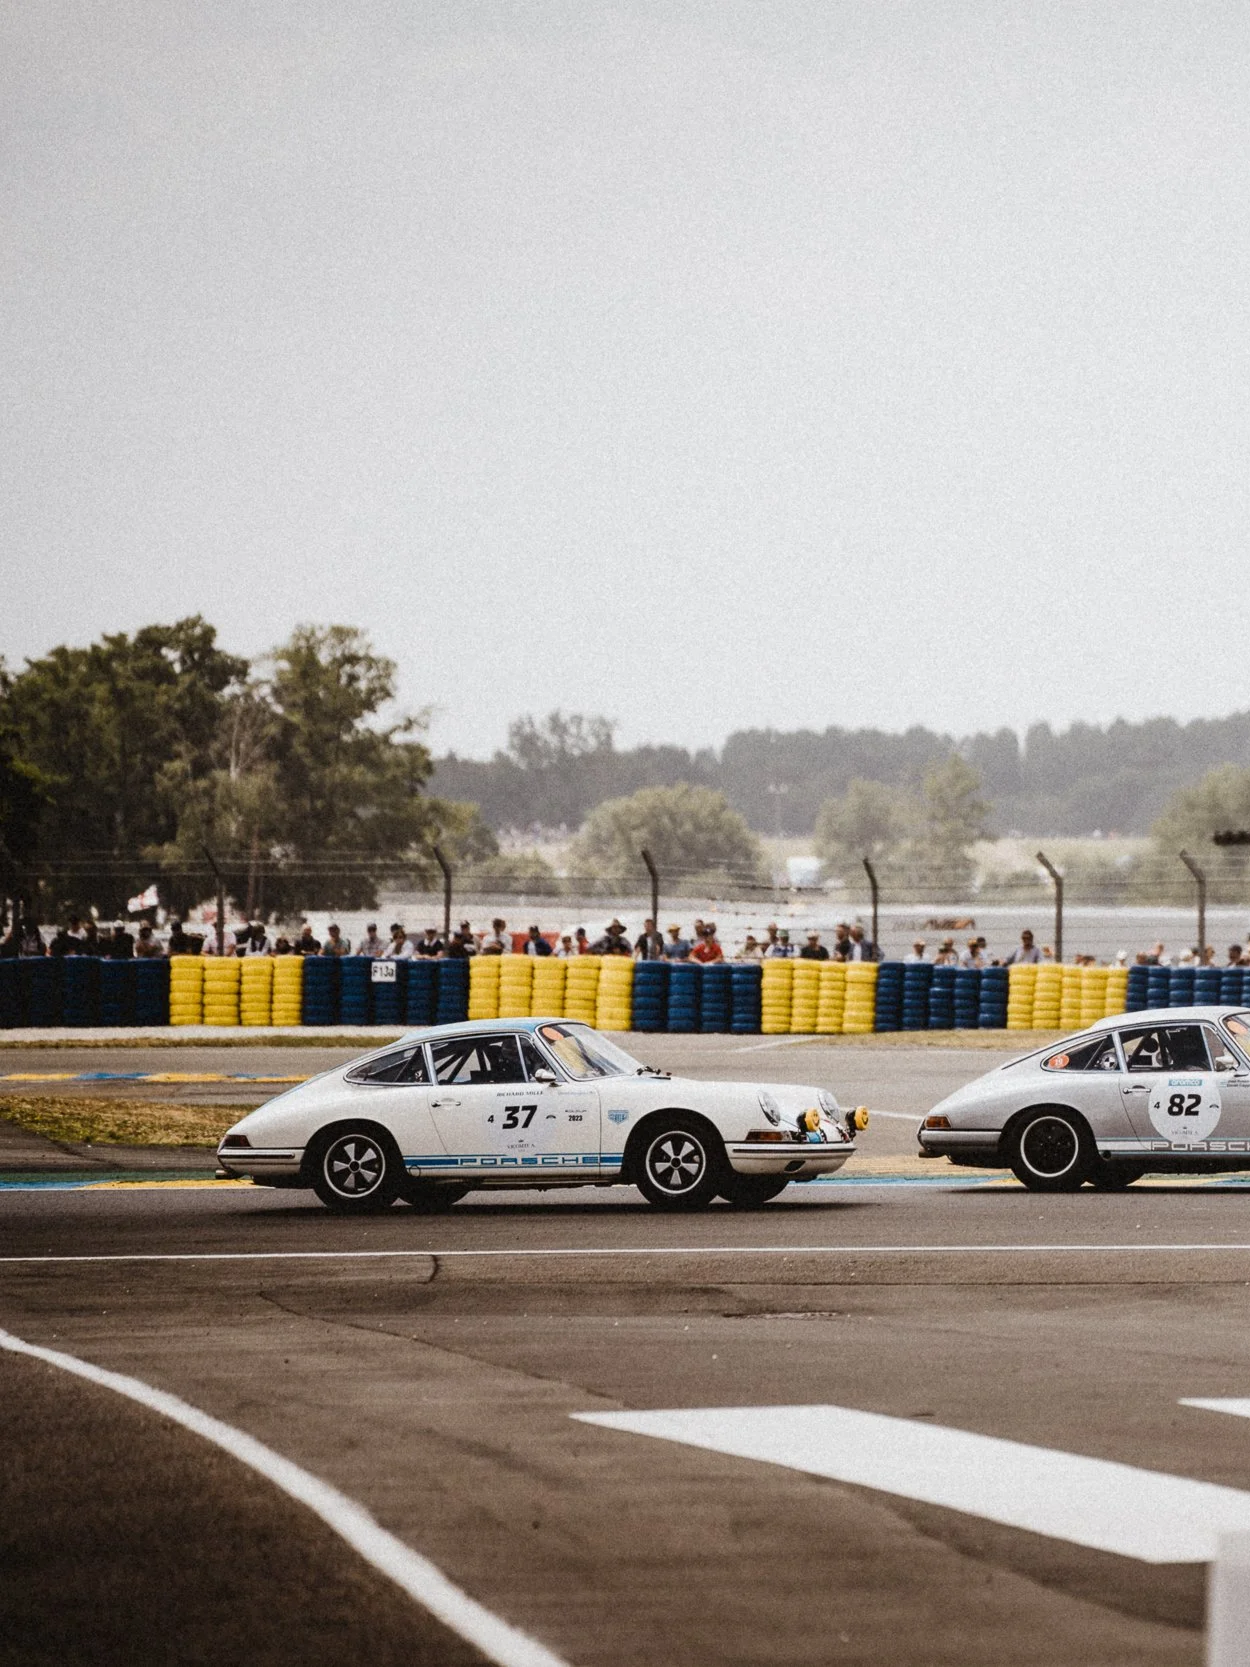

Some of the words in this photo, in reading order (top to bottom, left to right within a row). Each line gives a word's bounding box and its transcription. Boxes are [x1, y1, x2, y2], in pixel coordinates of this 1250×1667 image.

[1153, 1101, 1161, 1110] 4
[1167, 1093, 1202, 1117] 82
[487, 1114, 495, 1124] 4
[502, 1104, 538, 1130] 37
[568, 1114, 583, 1122] 2023
[460, 1156, 599, 1166] PORSCHE
